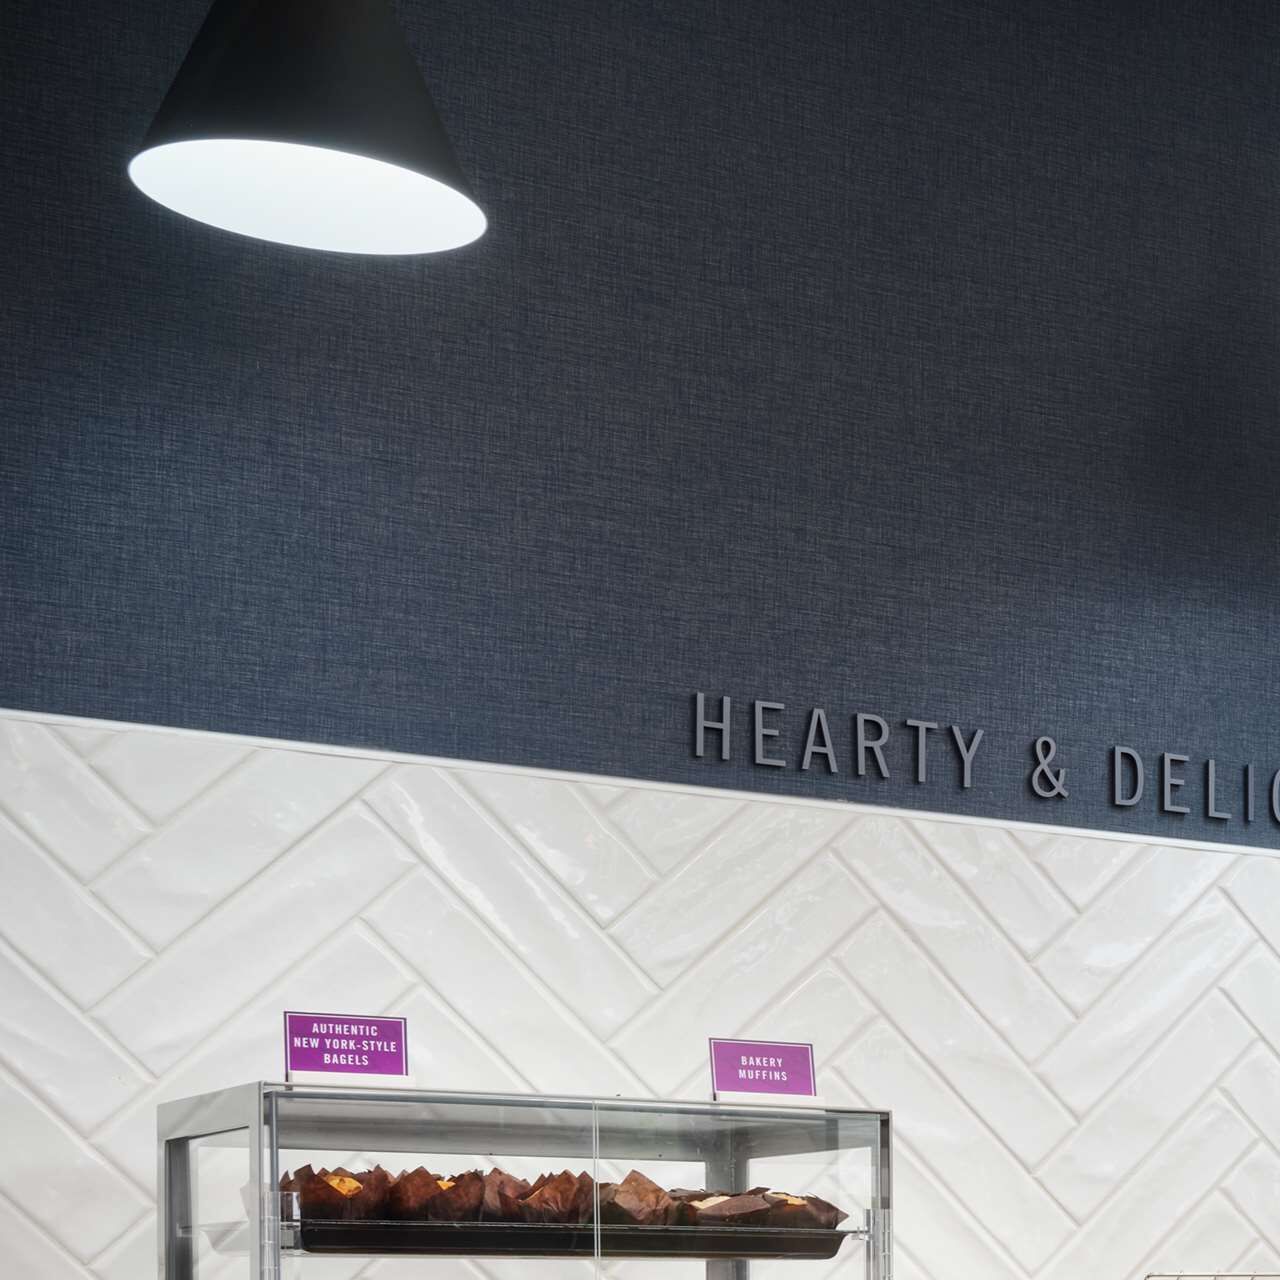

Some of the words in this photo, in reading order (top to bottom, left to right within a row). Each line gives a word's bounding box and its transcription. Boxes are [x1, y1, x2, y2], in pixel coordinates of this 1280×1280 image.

[694, 691, 986, 788] HEARTY
[1032, 736, 1070, 799] &
[311, 1023, 378, 1036] AUTHENTIC
[293, 1037, 320, 1049] NEW
[324, 1038, 397, 1052] YORK-STYLE
[323, 1053, 369, 1066] BAGELS
[741, 1055, 783, 1067] BAKERY
[738, 1069, 788, 1081] MUFFINS
